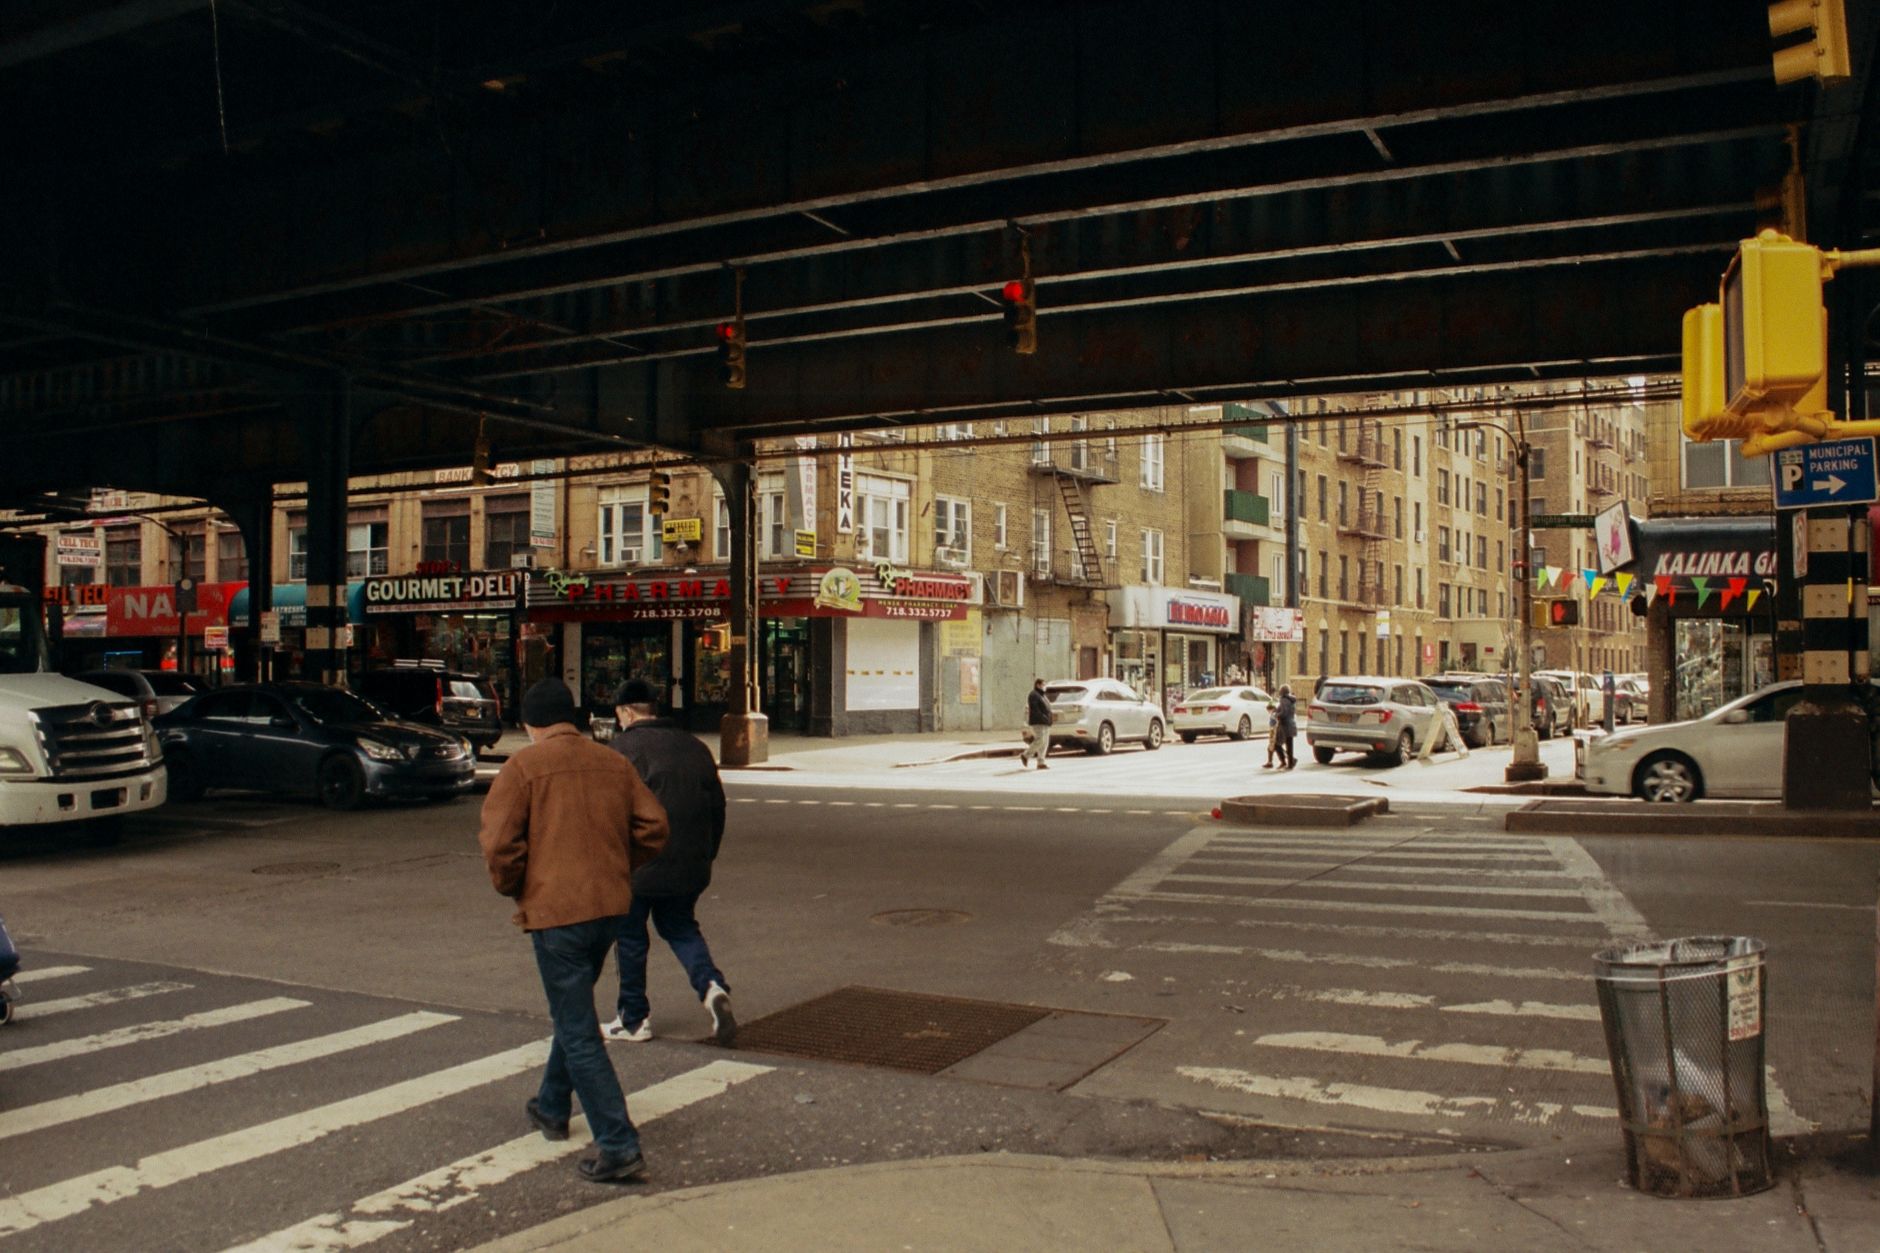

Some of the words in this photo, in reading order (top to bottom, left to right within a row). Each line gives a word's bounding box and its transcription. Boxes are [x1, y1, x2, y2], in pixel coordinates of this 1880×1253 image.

[1808, 445, 1868, 459] MUNICIPAL
[439, 465, 516, 481] BANKTCY
[1809, 459, 1858, 473] PARKING
[1781, 465, 1803, 491] P
[1654, 552, 1750, 575] KALINKA
[367, 578, 463, 601] GOURMET
[470, 575, 516, 597] DELI
[566, 577, 792, 601] PHARMAY
[895, 577, 972, 600] PHARMACY
[633, 608, 721, 619] 718.332.3708
[886, 607, 952, 618] 718.332.5737
